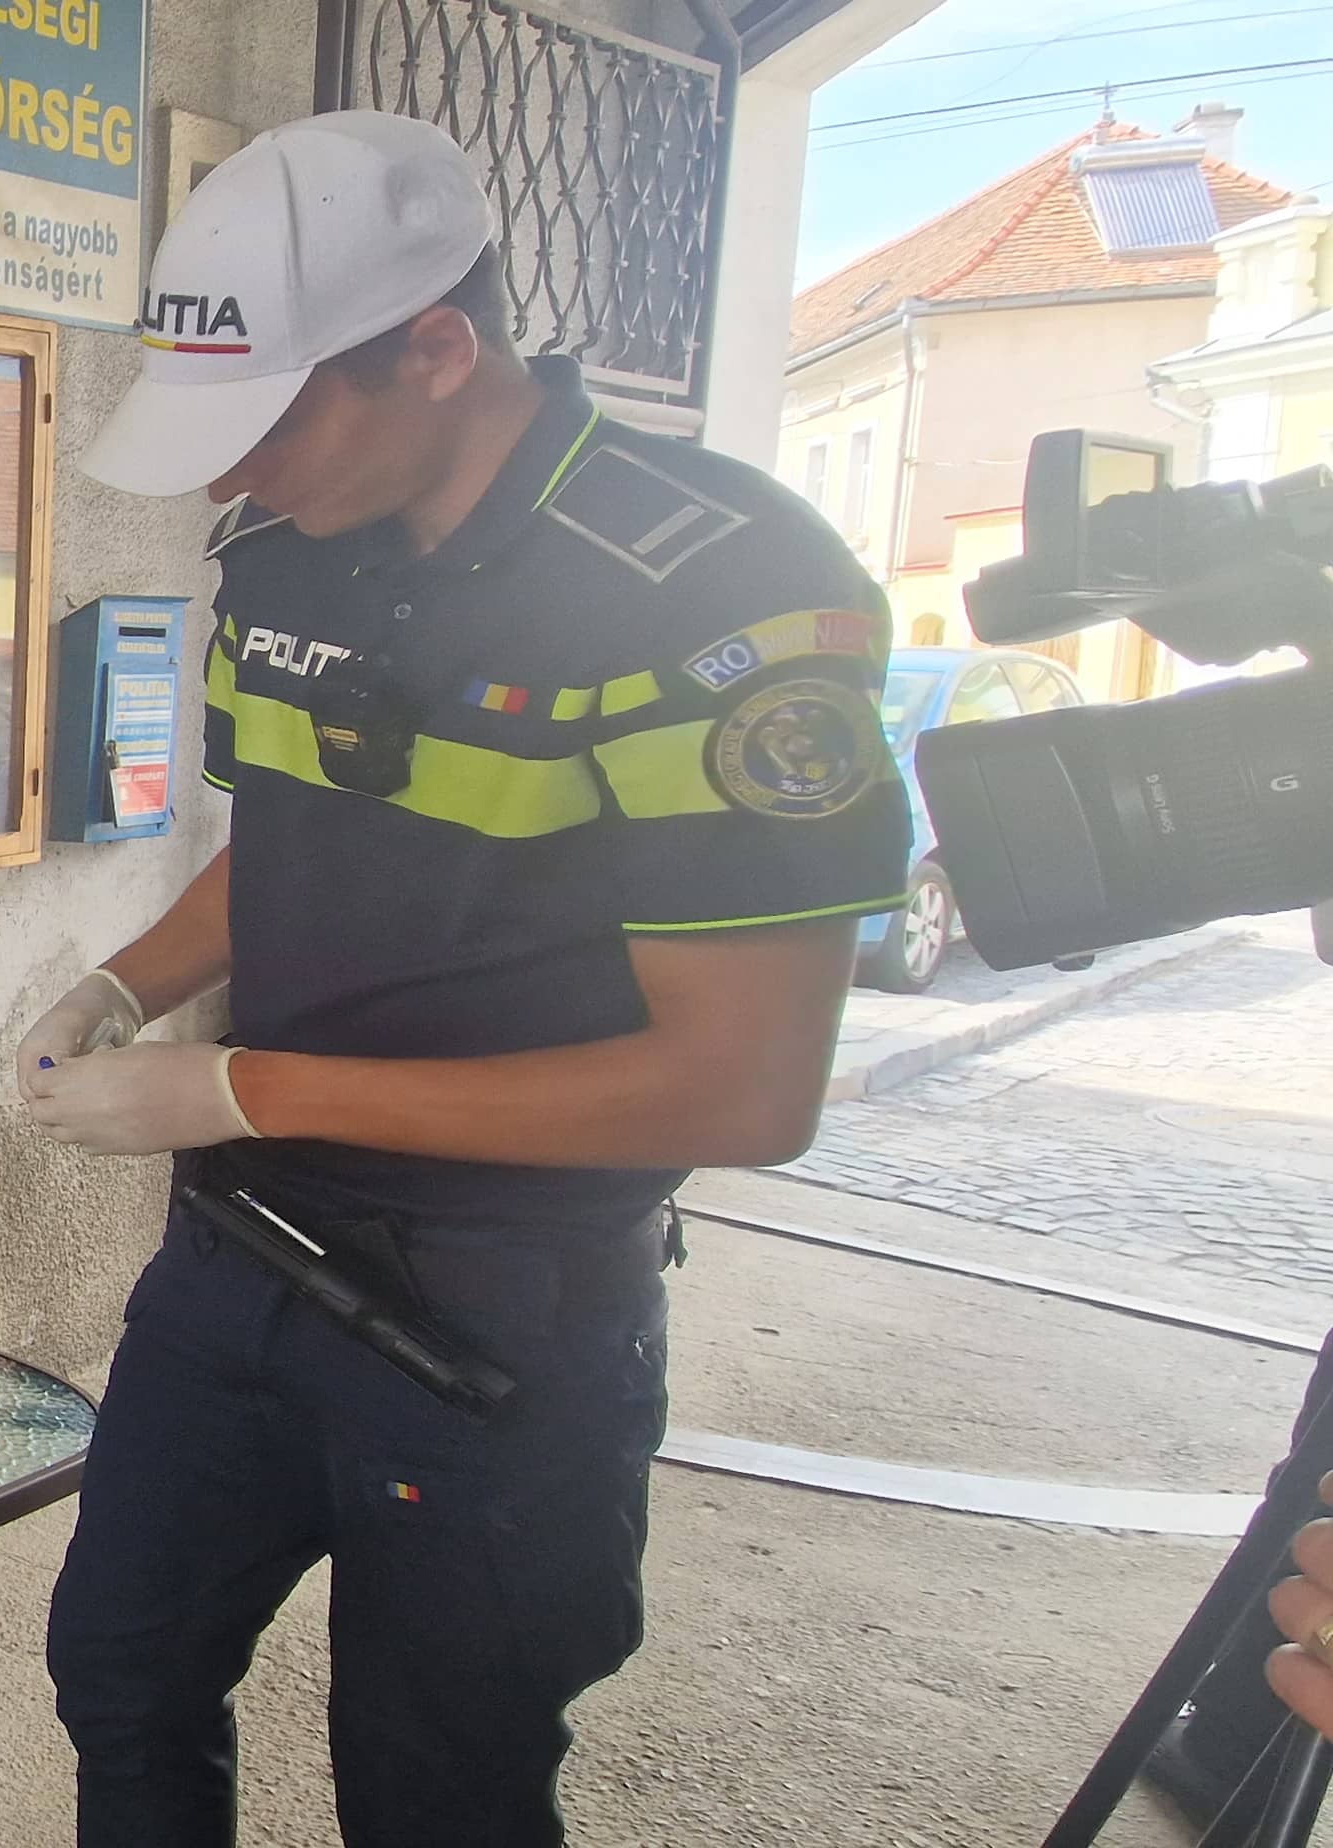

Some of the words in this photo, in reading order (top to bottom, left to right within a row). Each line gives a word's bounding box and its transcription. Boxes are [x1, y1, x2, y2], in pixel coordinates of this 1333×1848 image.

[3, 210, 17, 237] a
[24, 216, 118, 258] nagyobb
[241, 626, 365, 678] POLIT
